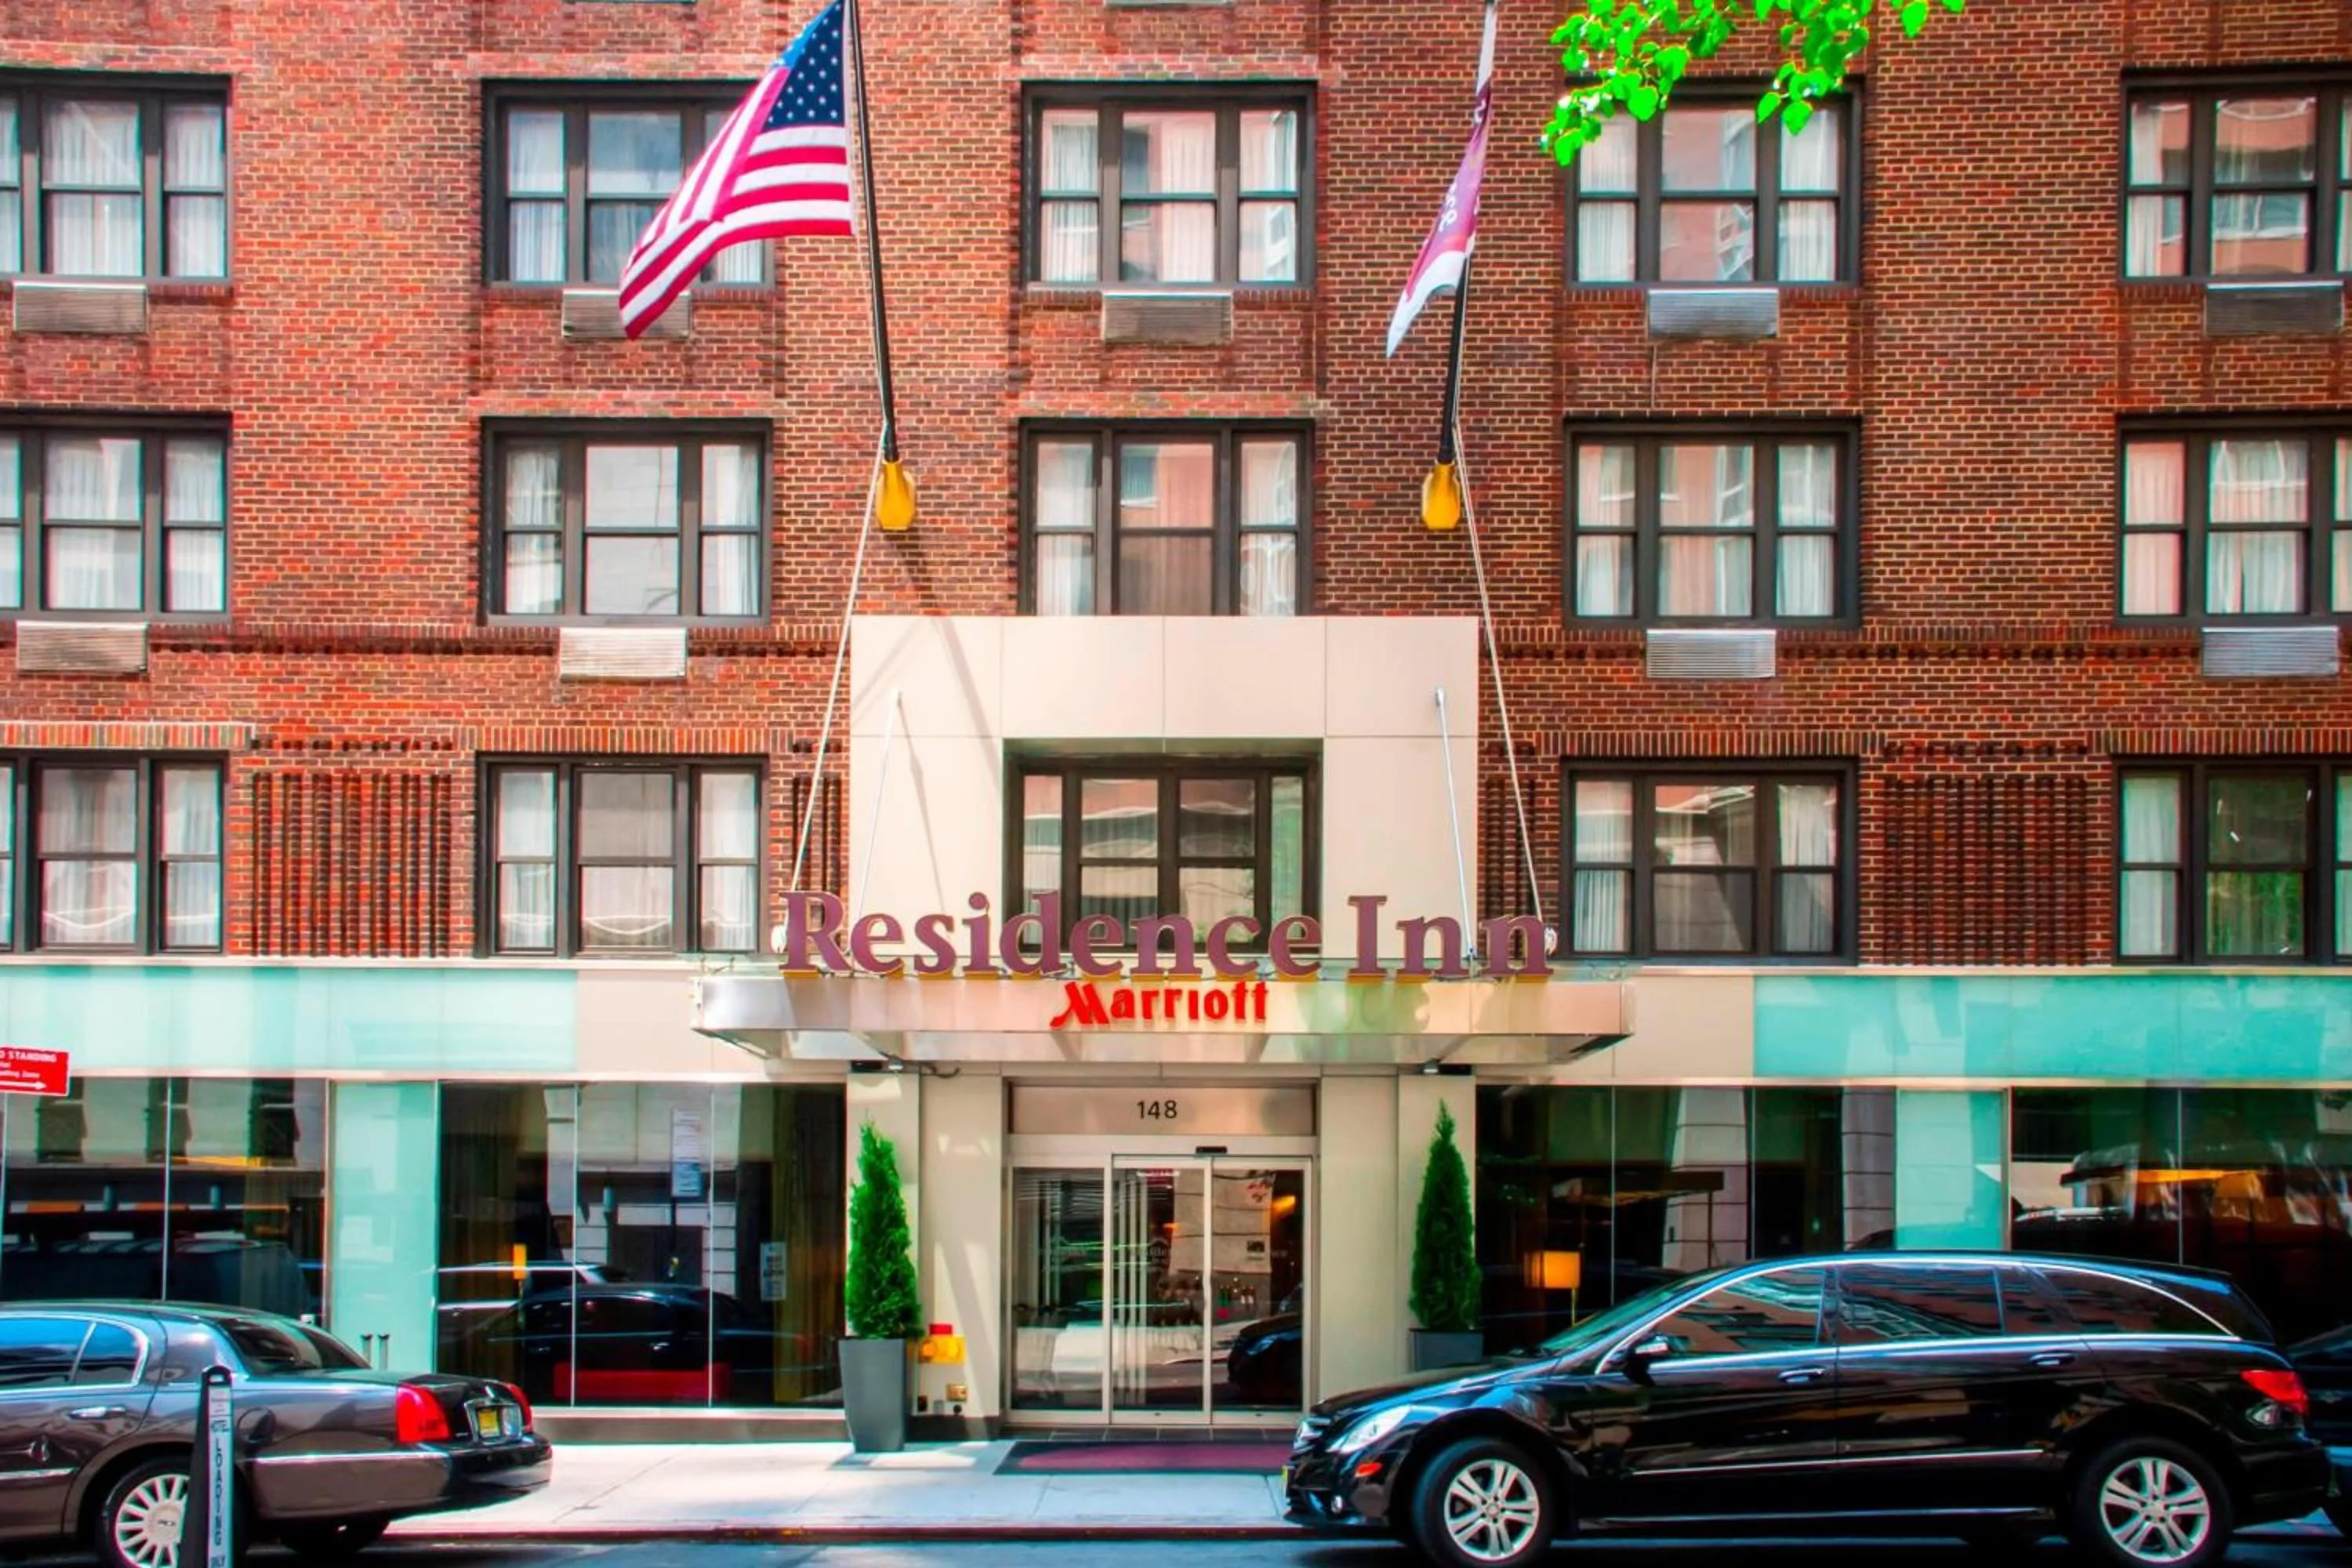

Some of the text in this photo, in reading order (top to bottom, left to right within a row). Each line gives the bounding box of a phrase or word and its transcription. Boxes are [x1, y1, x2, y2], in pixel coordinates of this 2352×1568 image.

[779, 891, 1555, 977] Residence Inn
[1050, 981, 1269, 1029] Marriott
[9, 1051, 57, 1063] STANDING
[1137, 1100, 1178, 1120] 148
